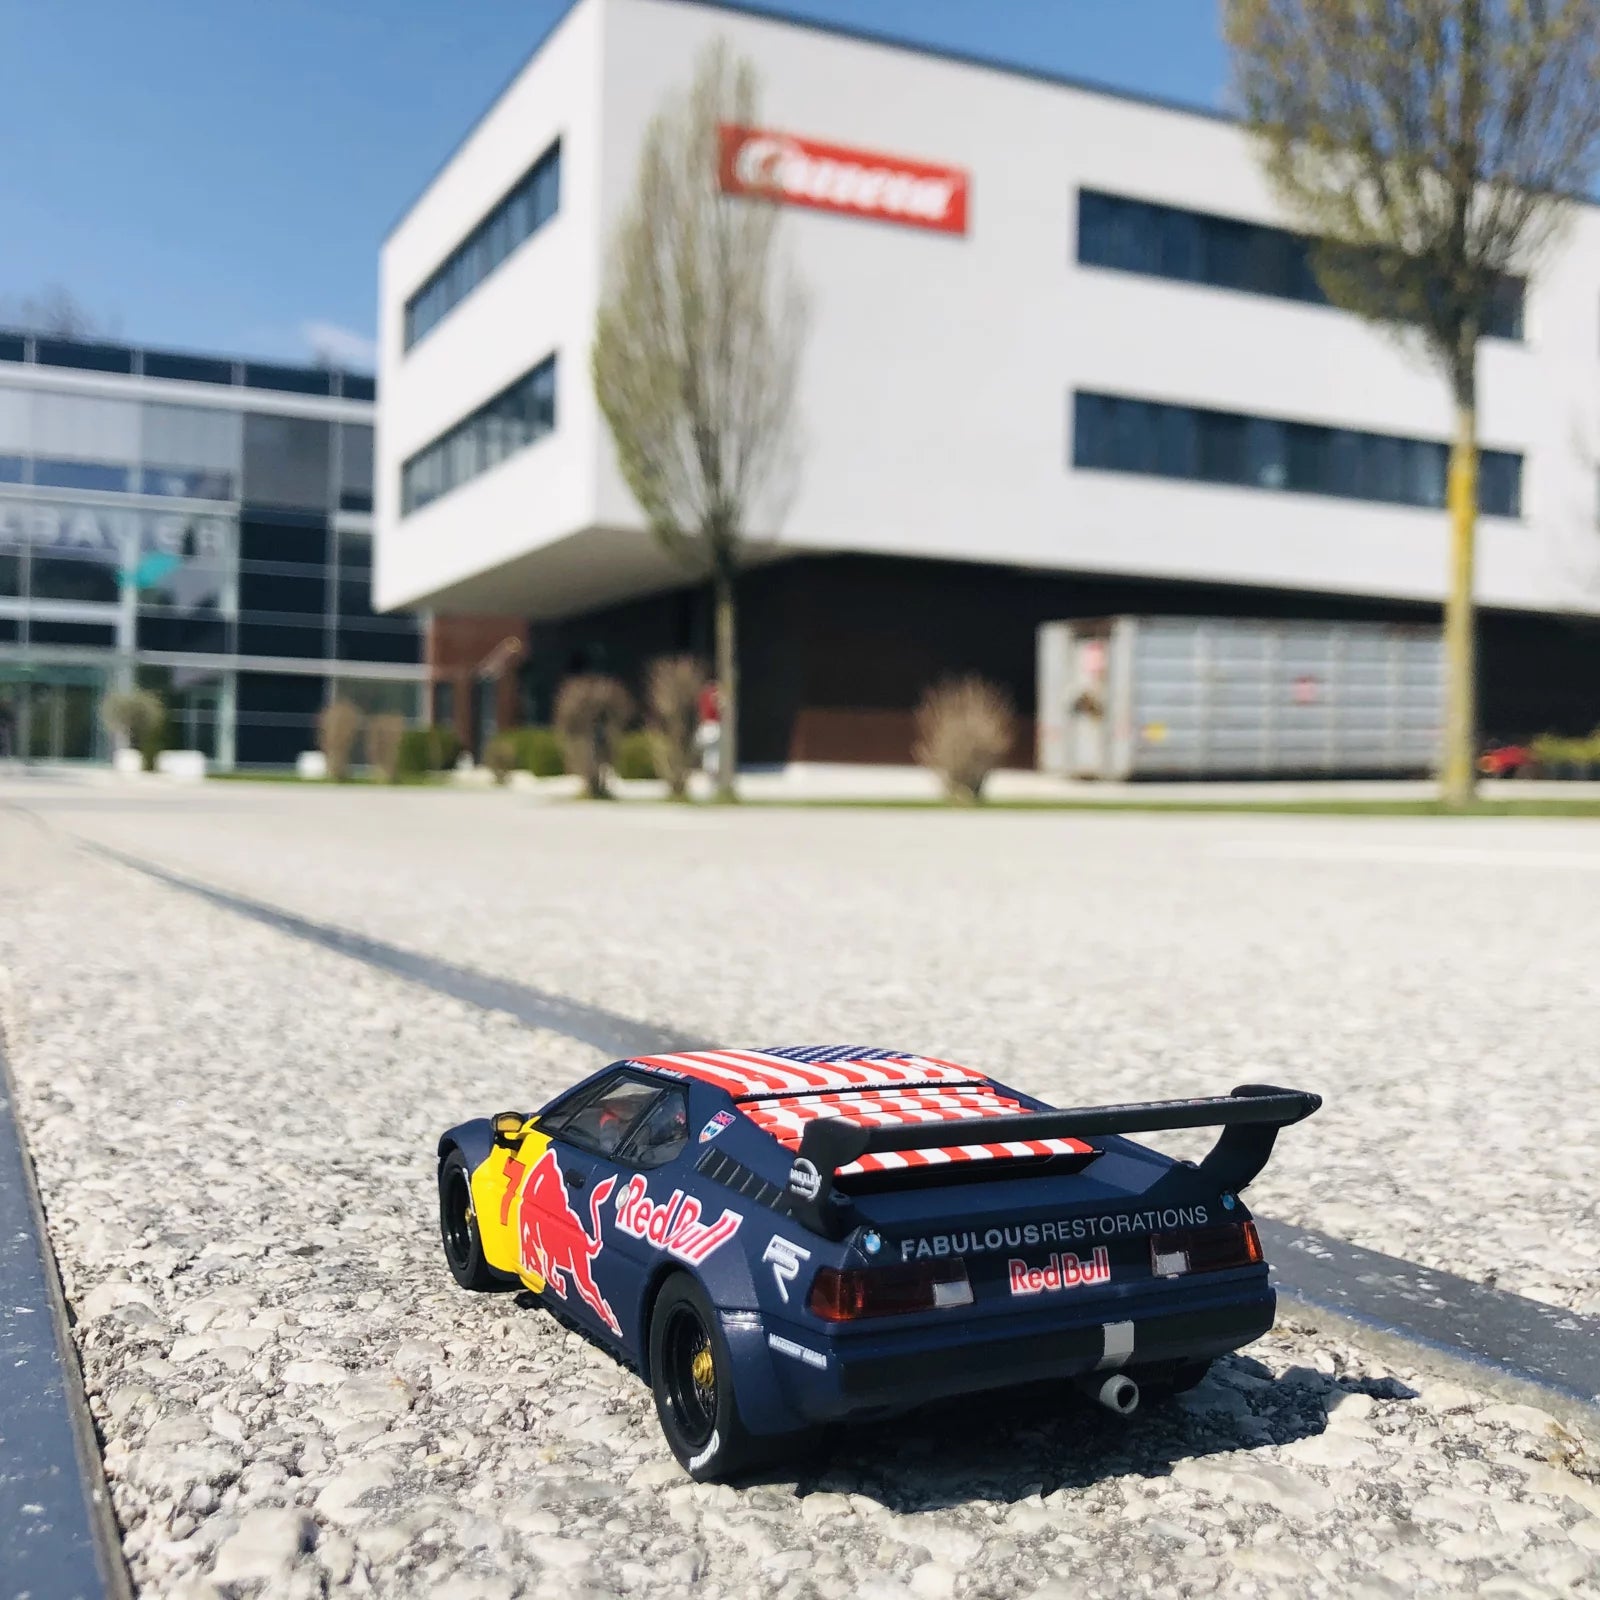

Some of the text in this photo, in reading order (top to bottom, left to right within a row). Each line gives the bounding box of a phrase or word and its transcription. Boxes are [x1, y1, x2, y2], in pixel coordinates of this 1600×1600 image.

[616, 1174, 742, 1264] Red Bull
[1010, 1246, 1110, 1294] Red Bull
